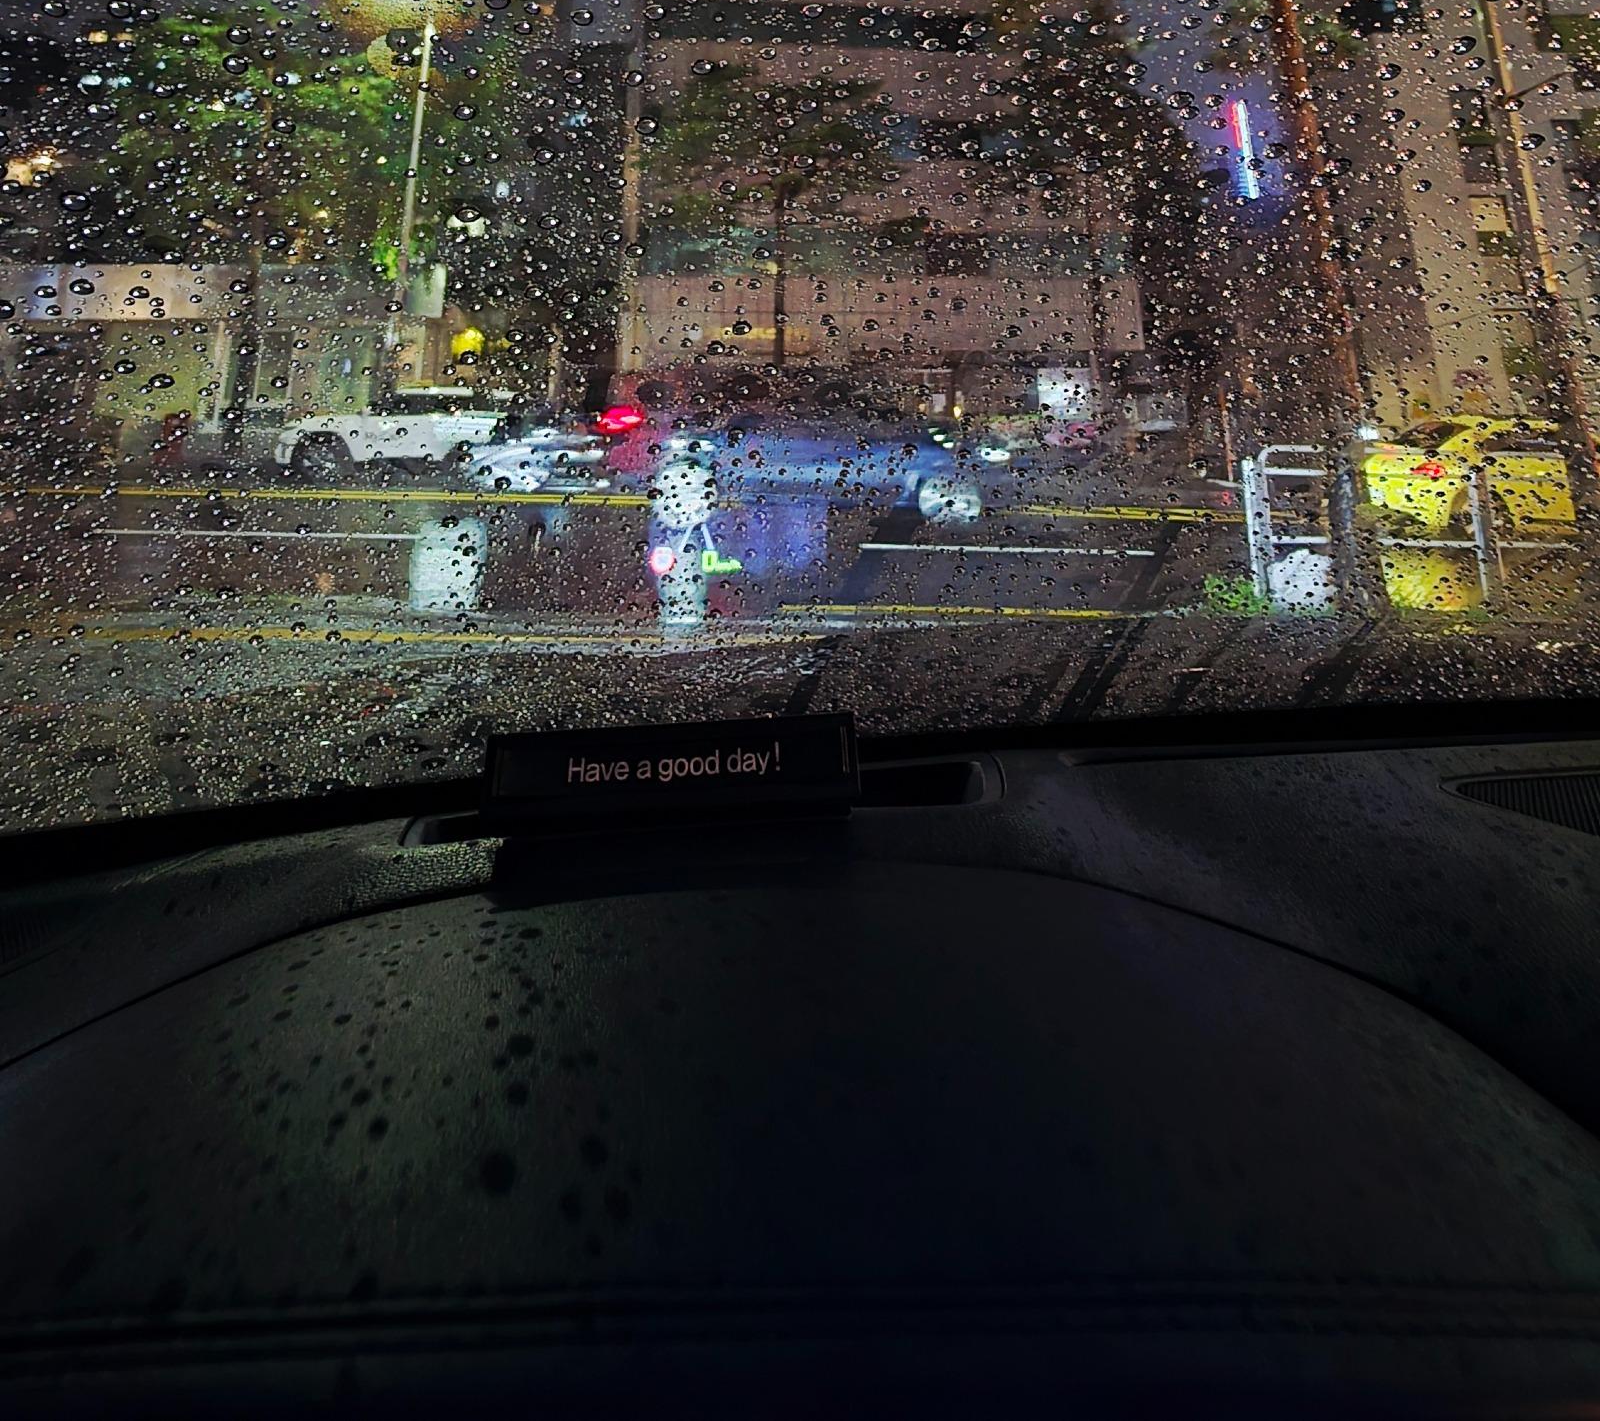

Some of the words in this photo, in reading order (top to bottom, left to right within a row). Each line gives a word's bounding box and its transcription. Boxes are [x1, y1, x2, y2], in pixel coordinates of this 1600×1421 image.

[567, 757, 630, 783] Have
[636, 760, 652, 780] a
[658, 749, 720, 782] good
[726, 741, 781, 775] day!
